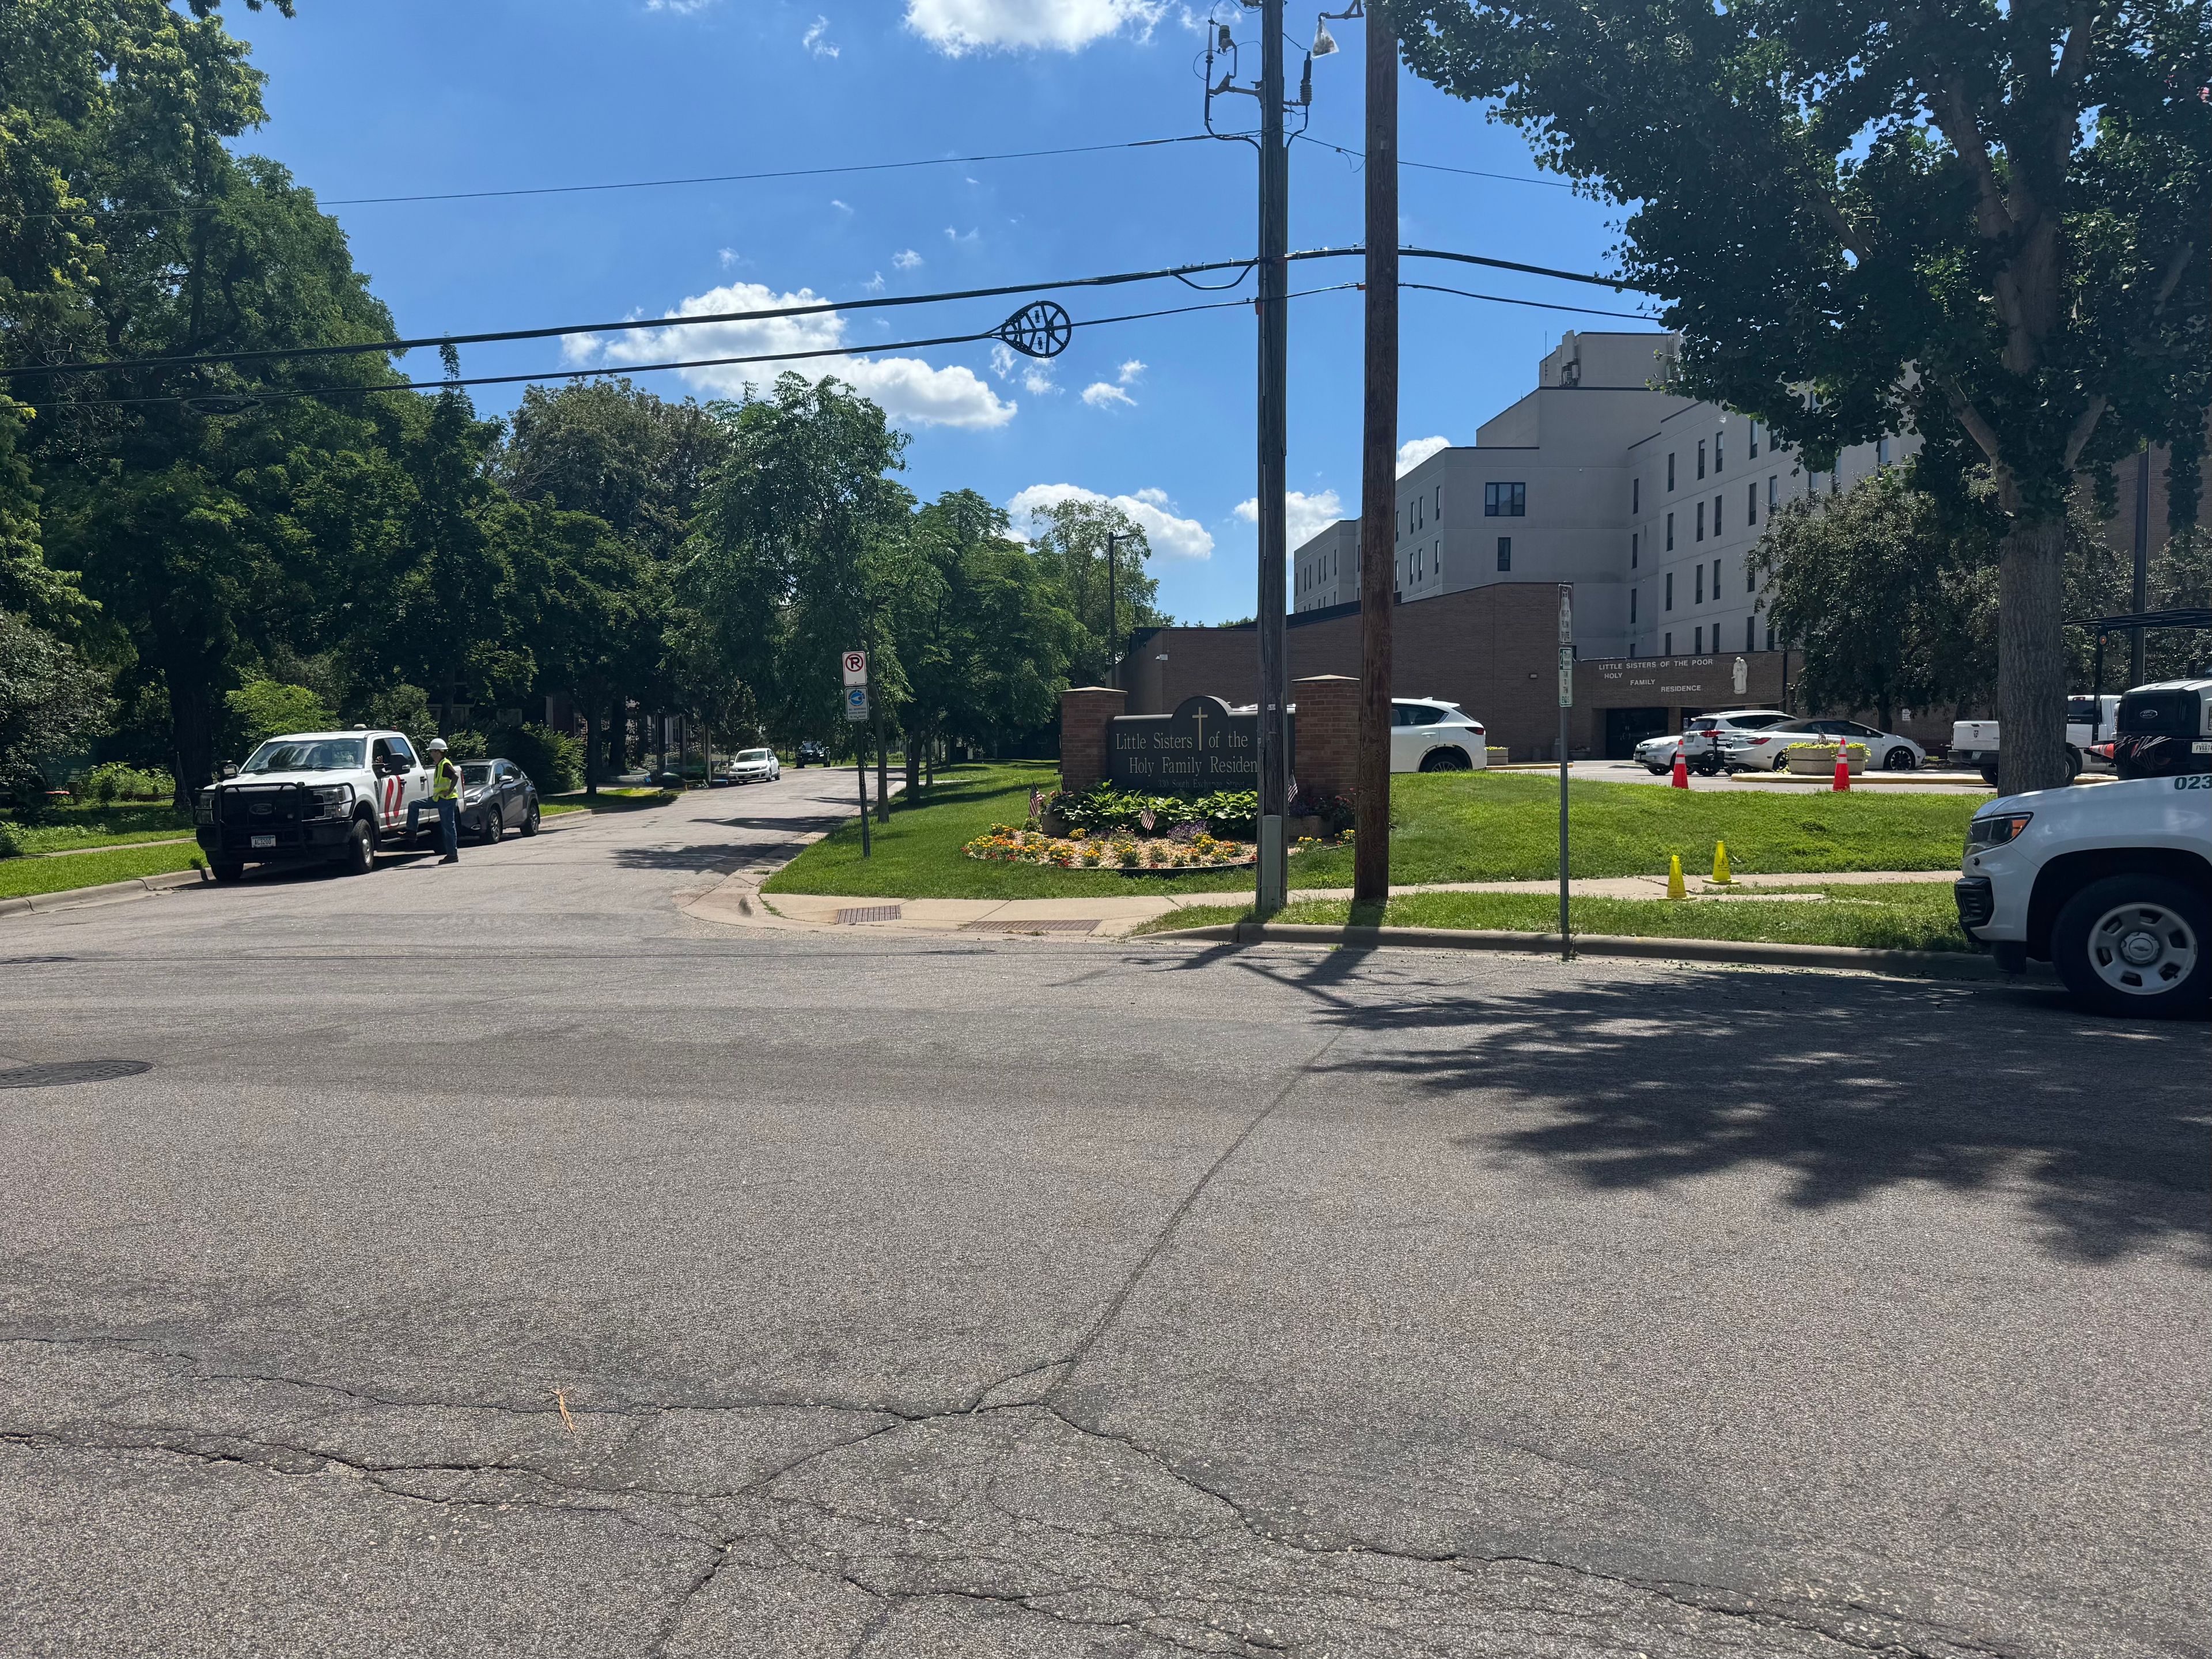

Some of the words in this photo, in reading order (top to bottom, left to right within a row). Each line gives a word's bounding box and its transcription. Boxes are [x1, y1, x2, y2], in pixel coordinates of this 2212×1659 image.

[1116, 733, 1146, 749] Little
[1153, 732, 1192, 749] Sisters
[1209, 731, 1220, 748] of
[1228, 730, 1248, 748] the
[1129, 757, 1154, 777] Holy
[1162, 756, 1202, 777] Family
[1210, 756, 1258, 773] Residen
[1172, 779, 1190, 788] South
[2174, 775, 2212, 790] 023
